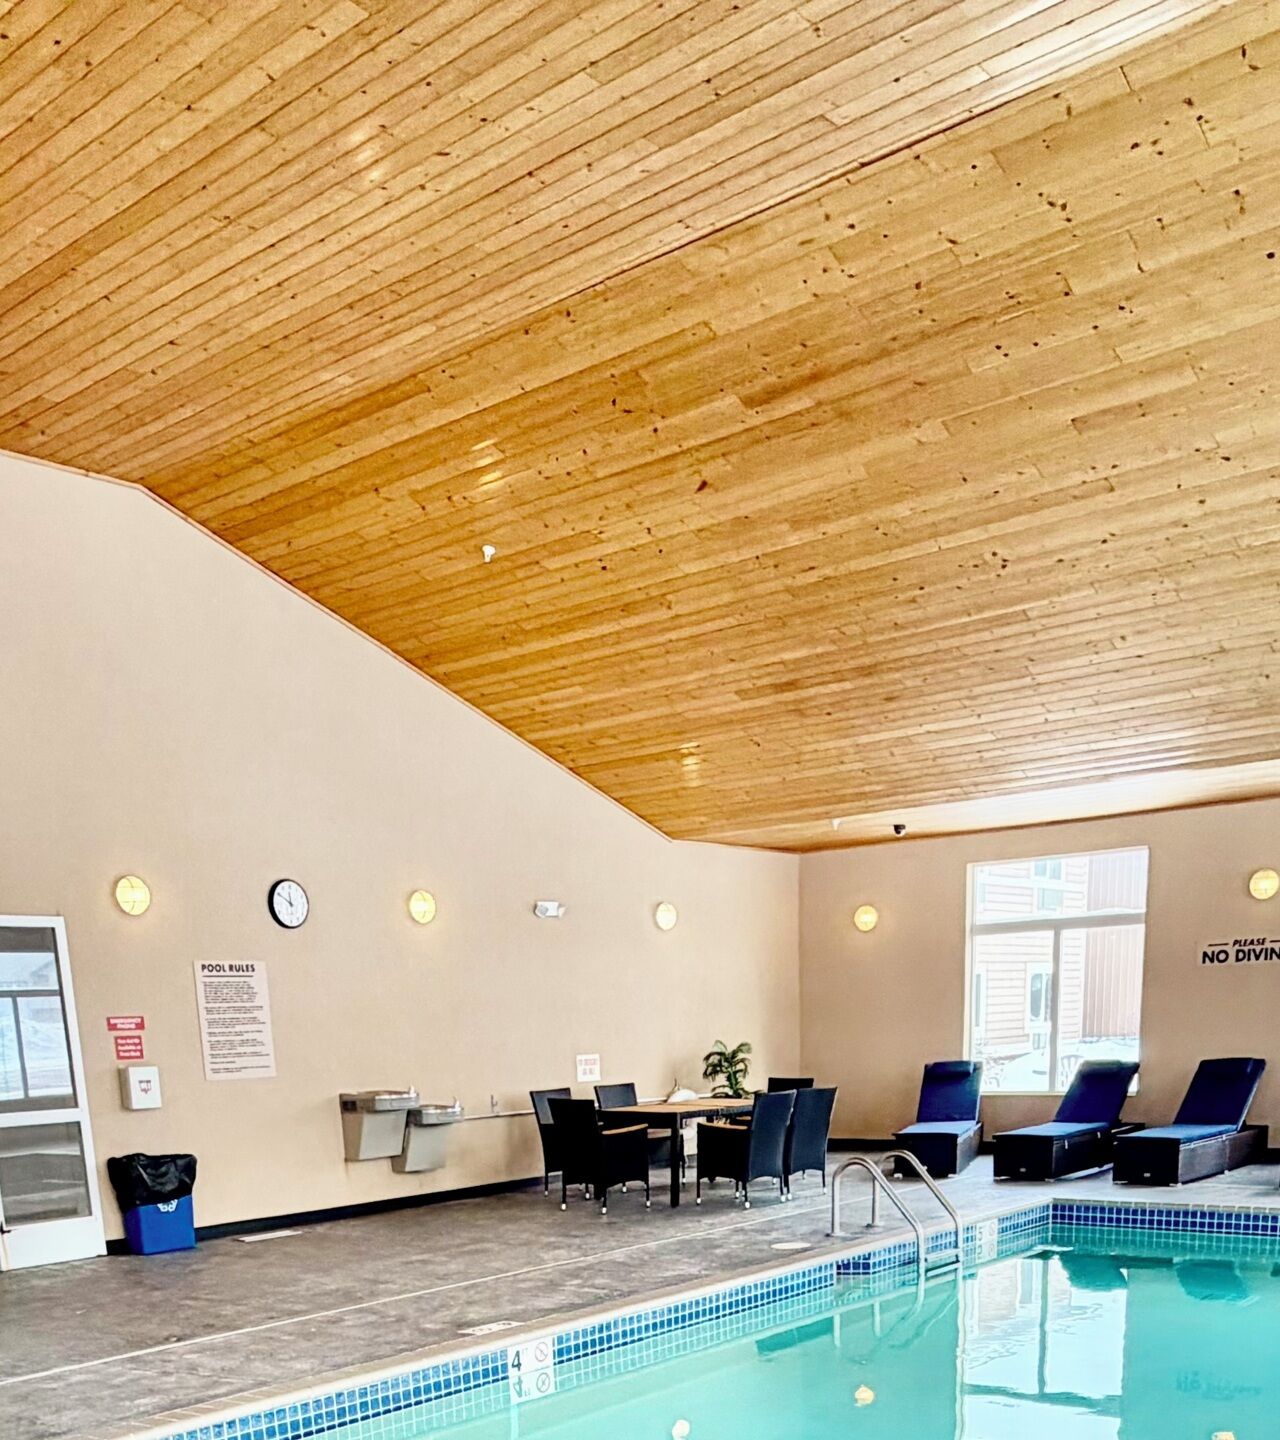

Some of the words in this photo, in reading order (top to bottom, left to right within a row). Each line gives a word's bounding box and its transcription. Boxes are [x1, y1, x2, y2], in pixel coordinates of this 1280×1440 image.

[1232, 937, 1267, 948] PLEASE
[1202, 949, 1229, 964] NO
[201, 963, 226, 973] POOL
[228, 963, 255, 973] RULES
[511, 1350, 522, 1372] 4
